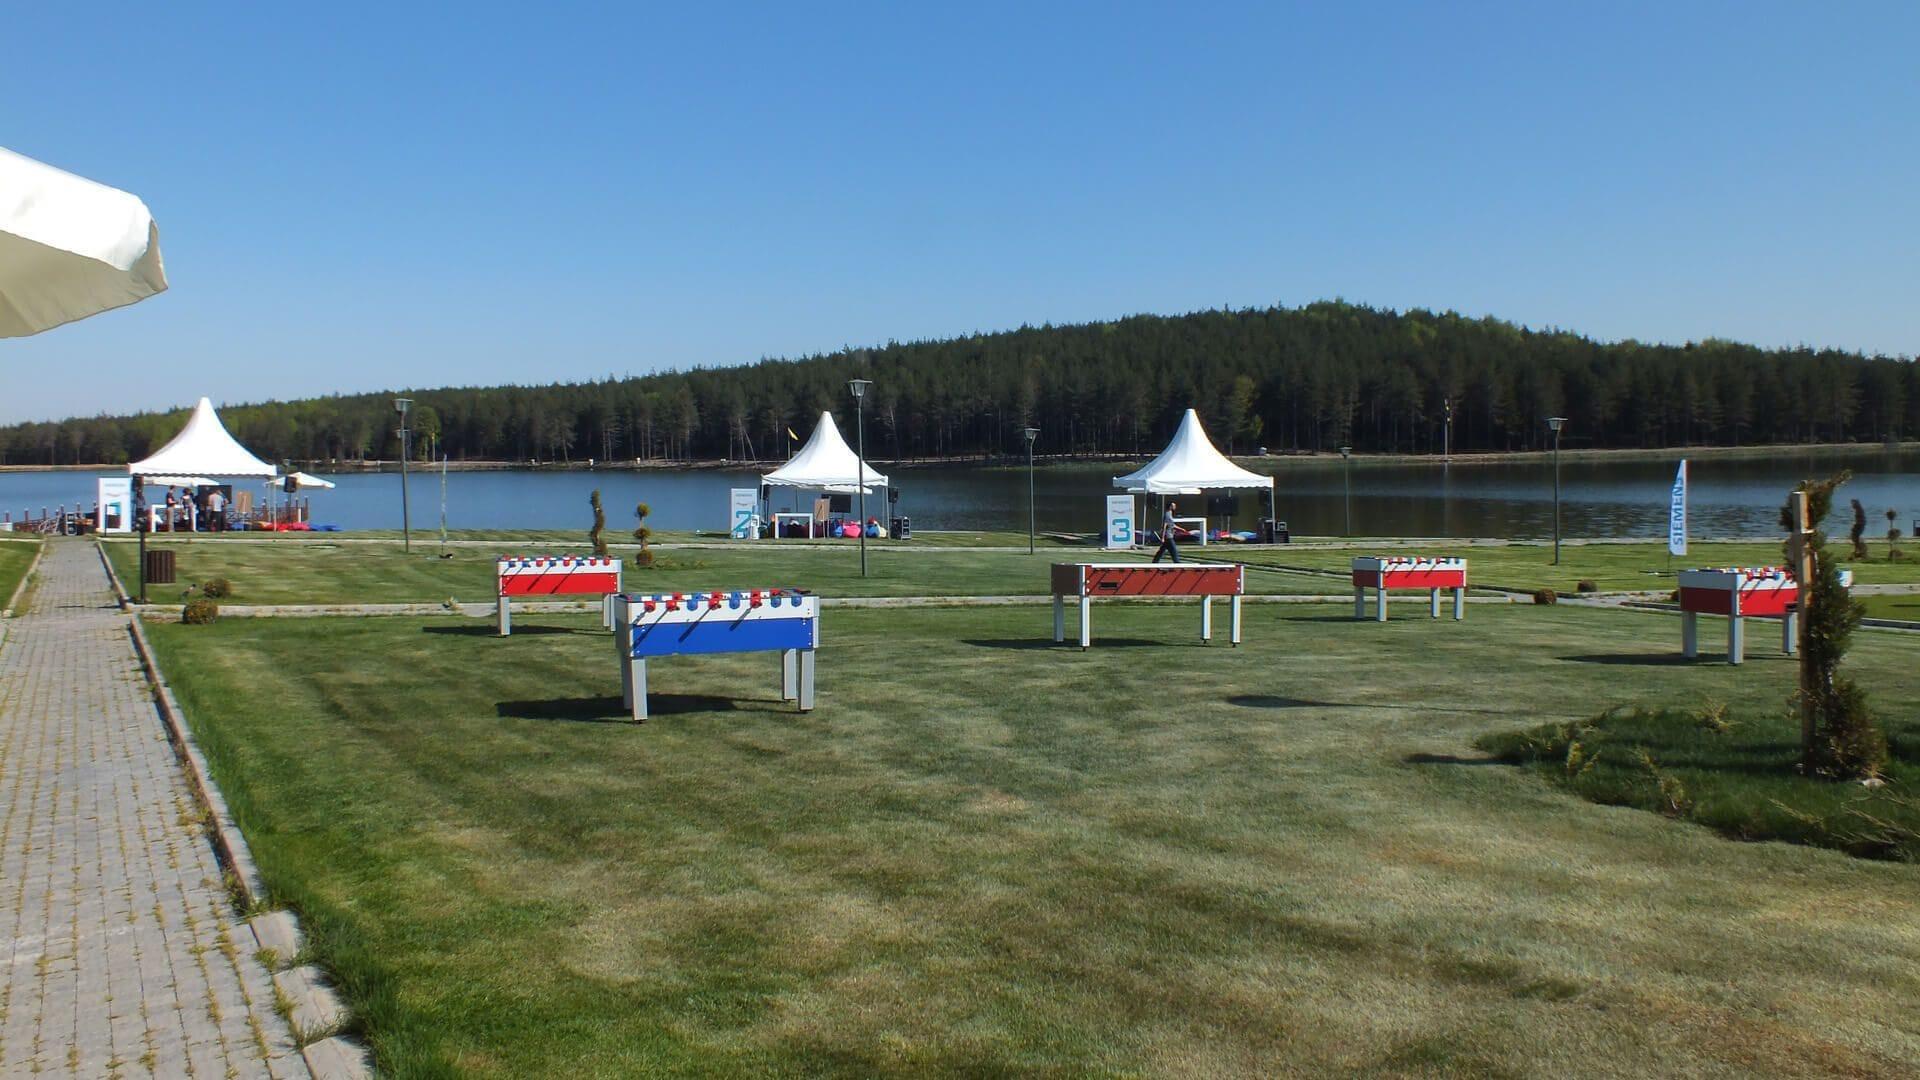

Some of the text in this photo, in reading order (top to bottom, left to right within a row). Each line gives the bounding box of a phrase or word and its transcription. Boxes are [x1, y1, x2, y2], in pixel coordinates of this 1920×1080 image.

[734, 510, 752, 532] 2
[1672, 477, 1684, 545] SIEMENS
[1112, 518, 1131, 542] 3
